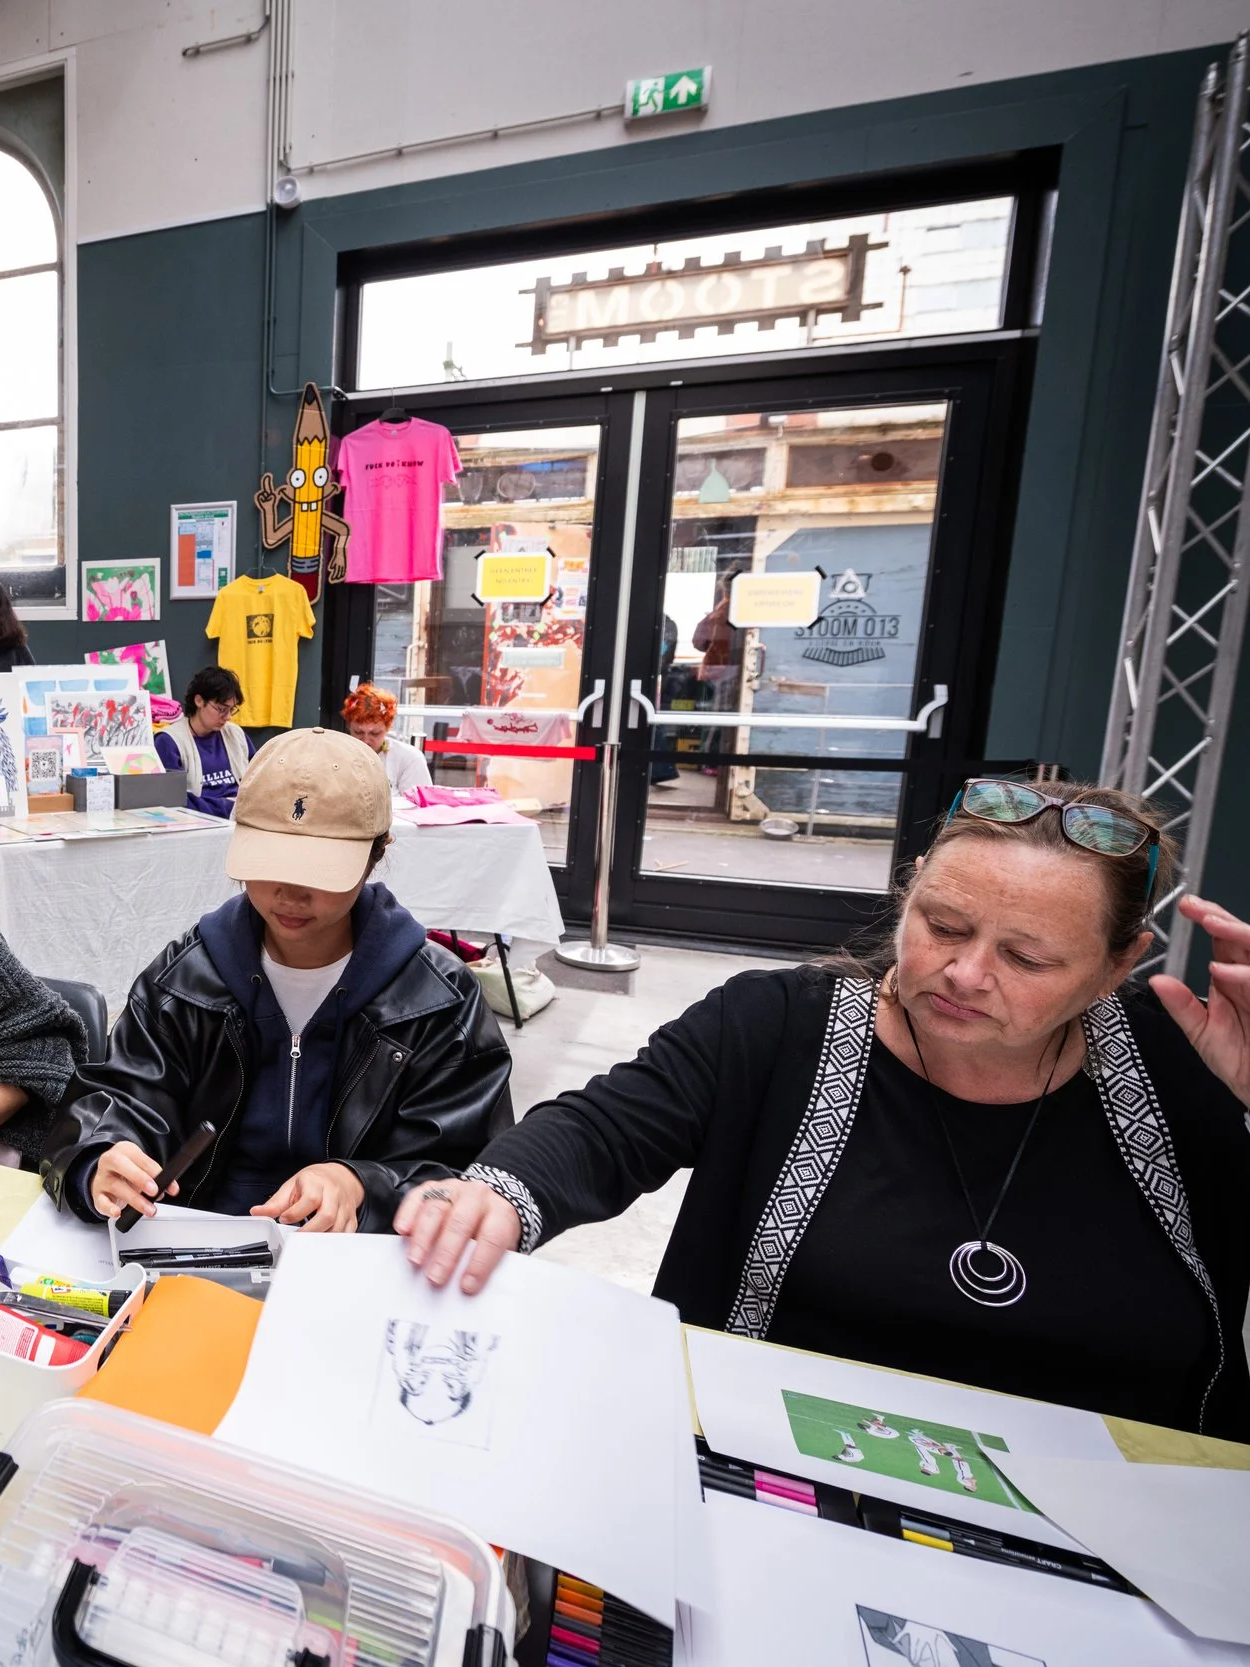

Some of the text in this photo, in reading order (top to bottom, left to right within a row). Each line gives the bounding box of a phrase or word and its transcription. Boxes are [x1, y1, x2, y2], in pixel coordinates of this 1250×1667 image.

[795, 616, 899, 637] SOOM 013
[202, 770, 232, 782] ILLIA
[1037, 1558, 1063, 1570] CRAFT
